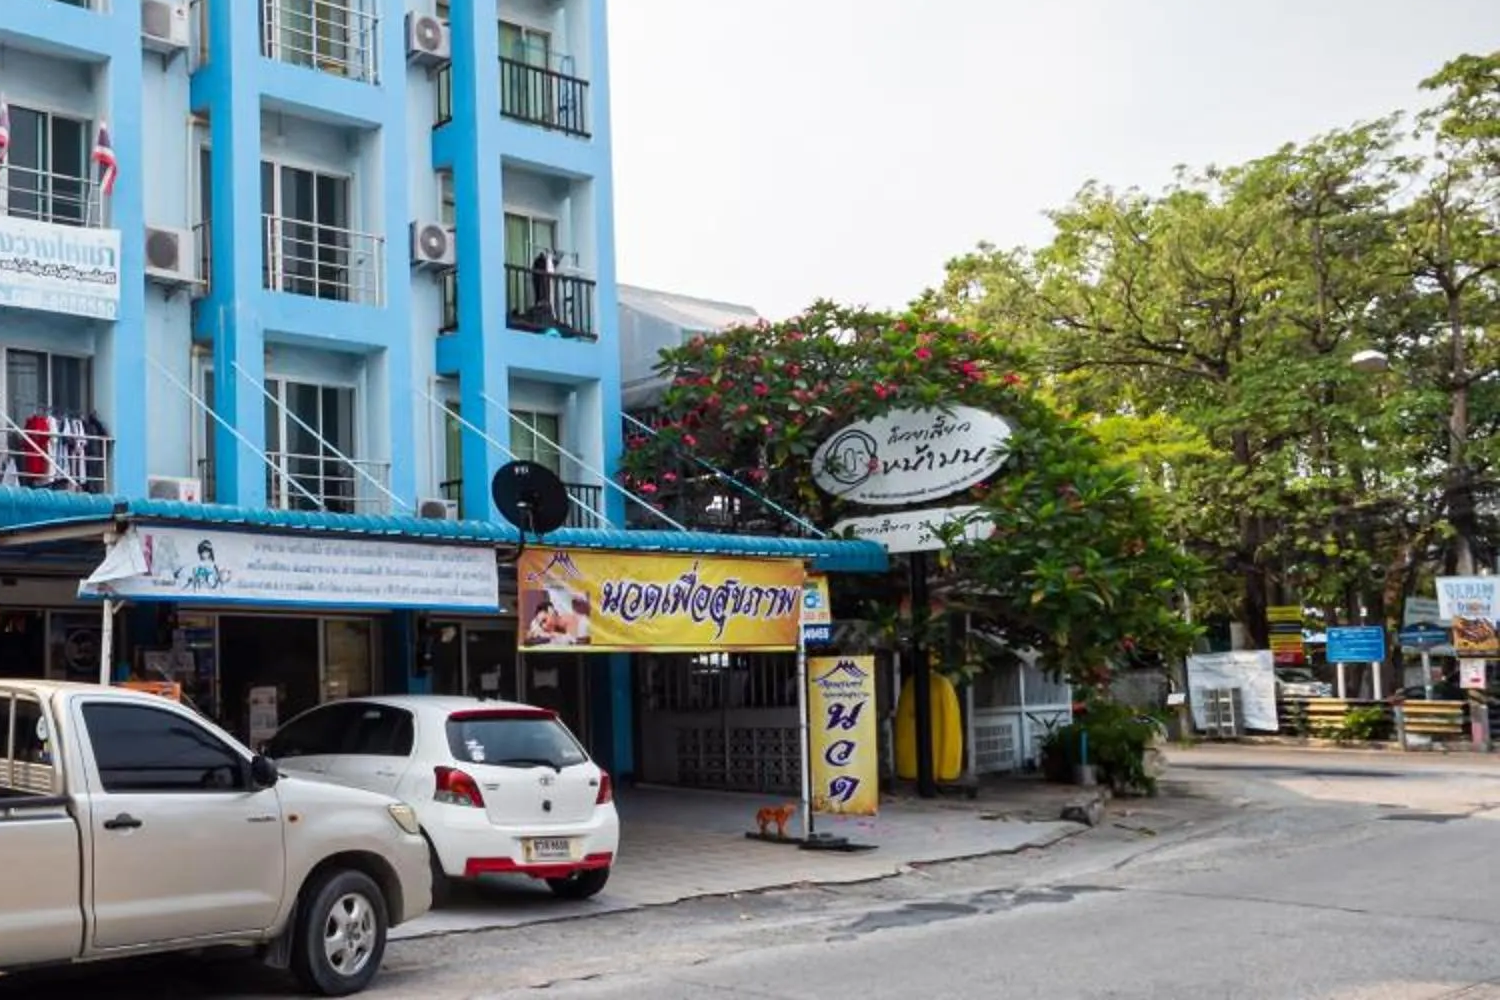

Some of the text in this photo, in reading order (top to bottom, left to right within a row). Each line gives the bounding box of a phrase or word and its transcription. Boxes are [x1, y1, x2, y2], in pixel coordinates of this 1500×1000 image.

[882, 444, 986, 475] หน้ามน
[602, 560, 799, 640] นวดเพื่อสุขภาพ
[824, 700, 866, 802] นวด
